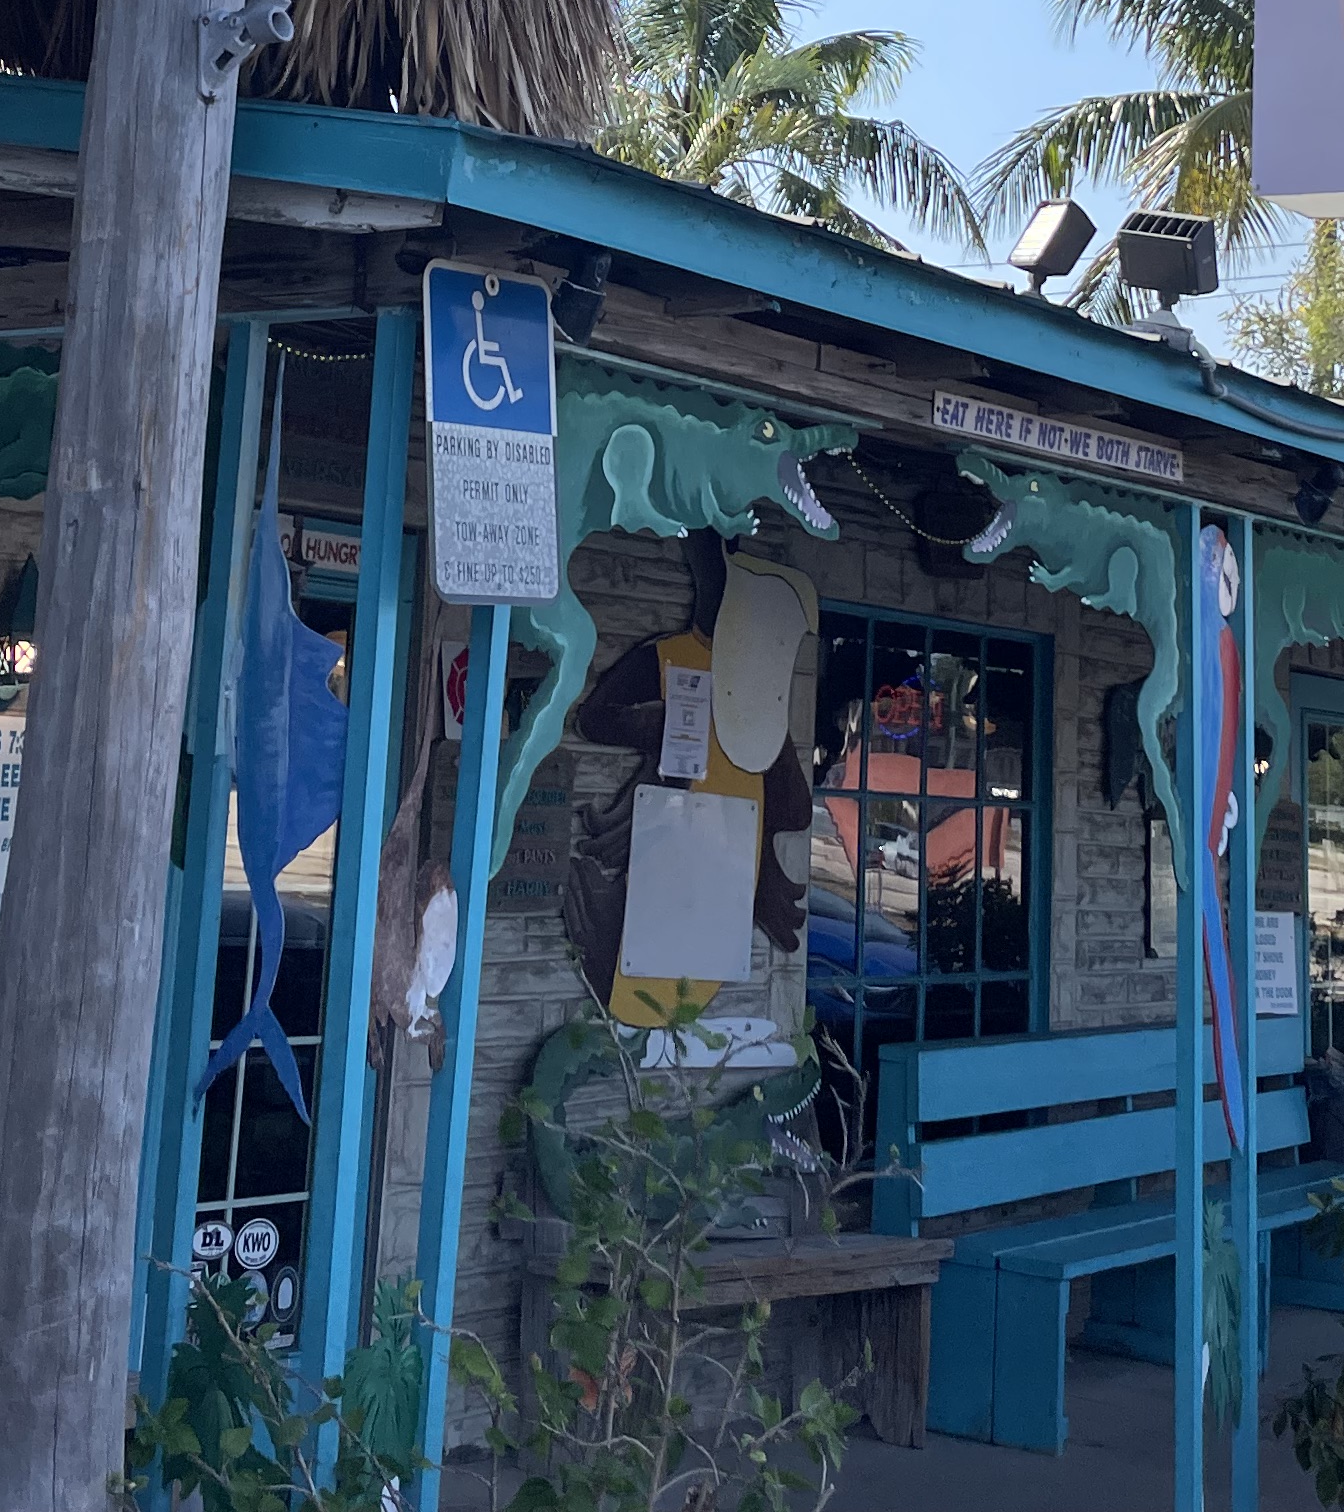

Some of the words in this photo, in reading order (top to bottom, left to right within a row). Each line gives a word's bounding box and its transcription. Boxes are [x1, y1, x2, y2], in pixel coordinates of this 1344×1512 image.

[941, 397, 969, 428] EAT
[974, 406, 1013, 438] HERE
[1020, 417, 1033, 442] IF
[1037, 422, 1065, 450] NOT
[1069, 429, 1090, 457] WE
[1096, 436, 1130, 466] BOTH
[1135, 445, 1177, 476] STARVE
[436, 434, 481, 460] PARKING
[486, 439, 499, 461] BY
[506, 441, 551, 466] DISABLED
[463, 479, 499, 503] PERMIT
[505, 482, 529, 505] ONLY
[456, 521, 509, 543] TOW-AWAY
[515, 525, 539, 546] ZONE
[306, 537, 360, 565] HUNGR
[444, 560, 451, 581] &
[457, 561, 479, 582] FINE
[484, 563, 497, 583] UP
[502, 564, 514, 584] TO
[519, 565, 541, 585] $250
[243, 1232, 270, 1253] KWO
